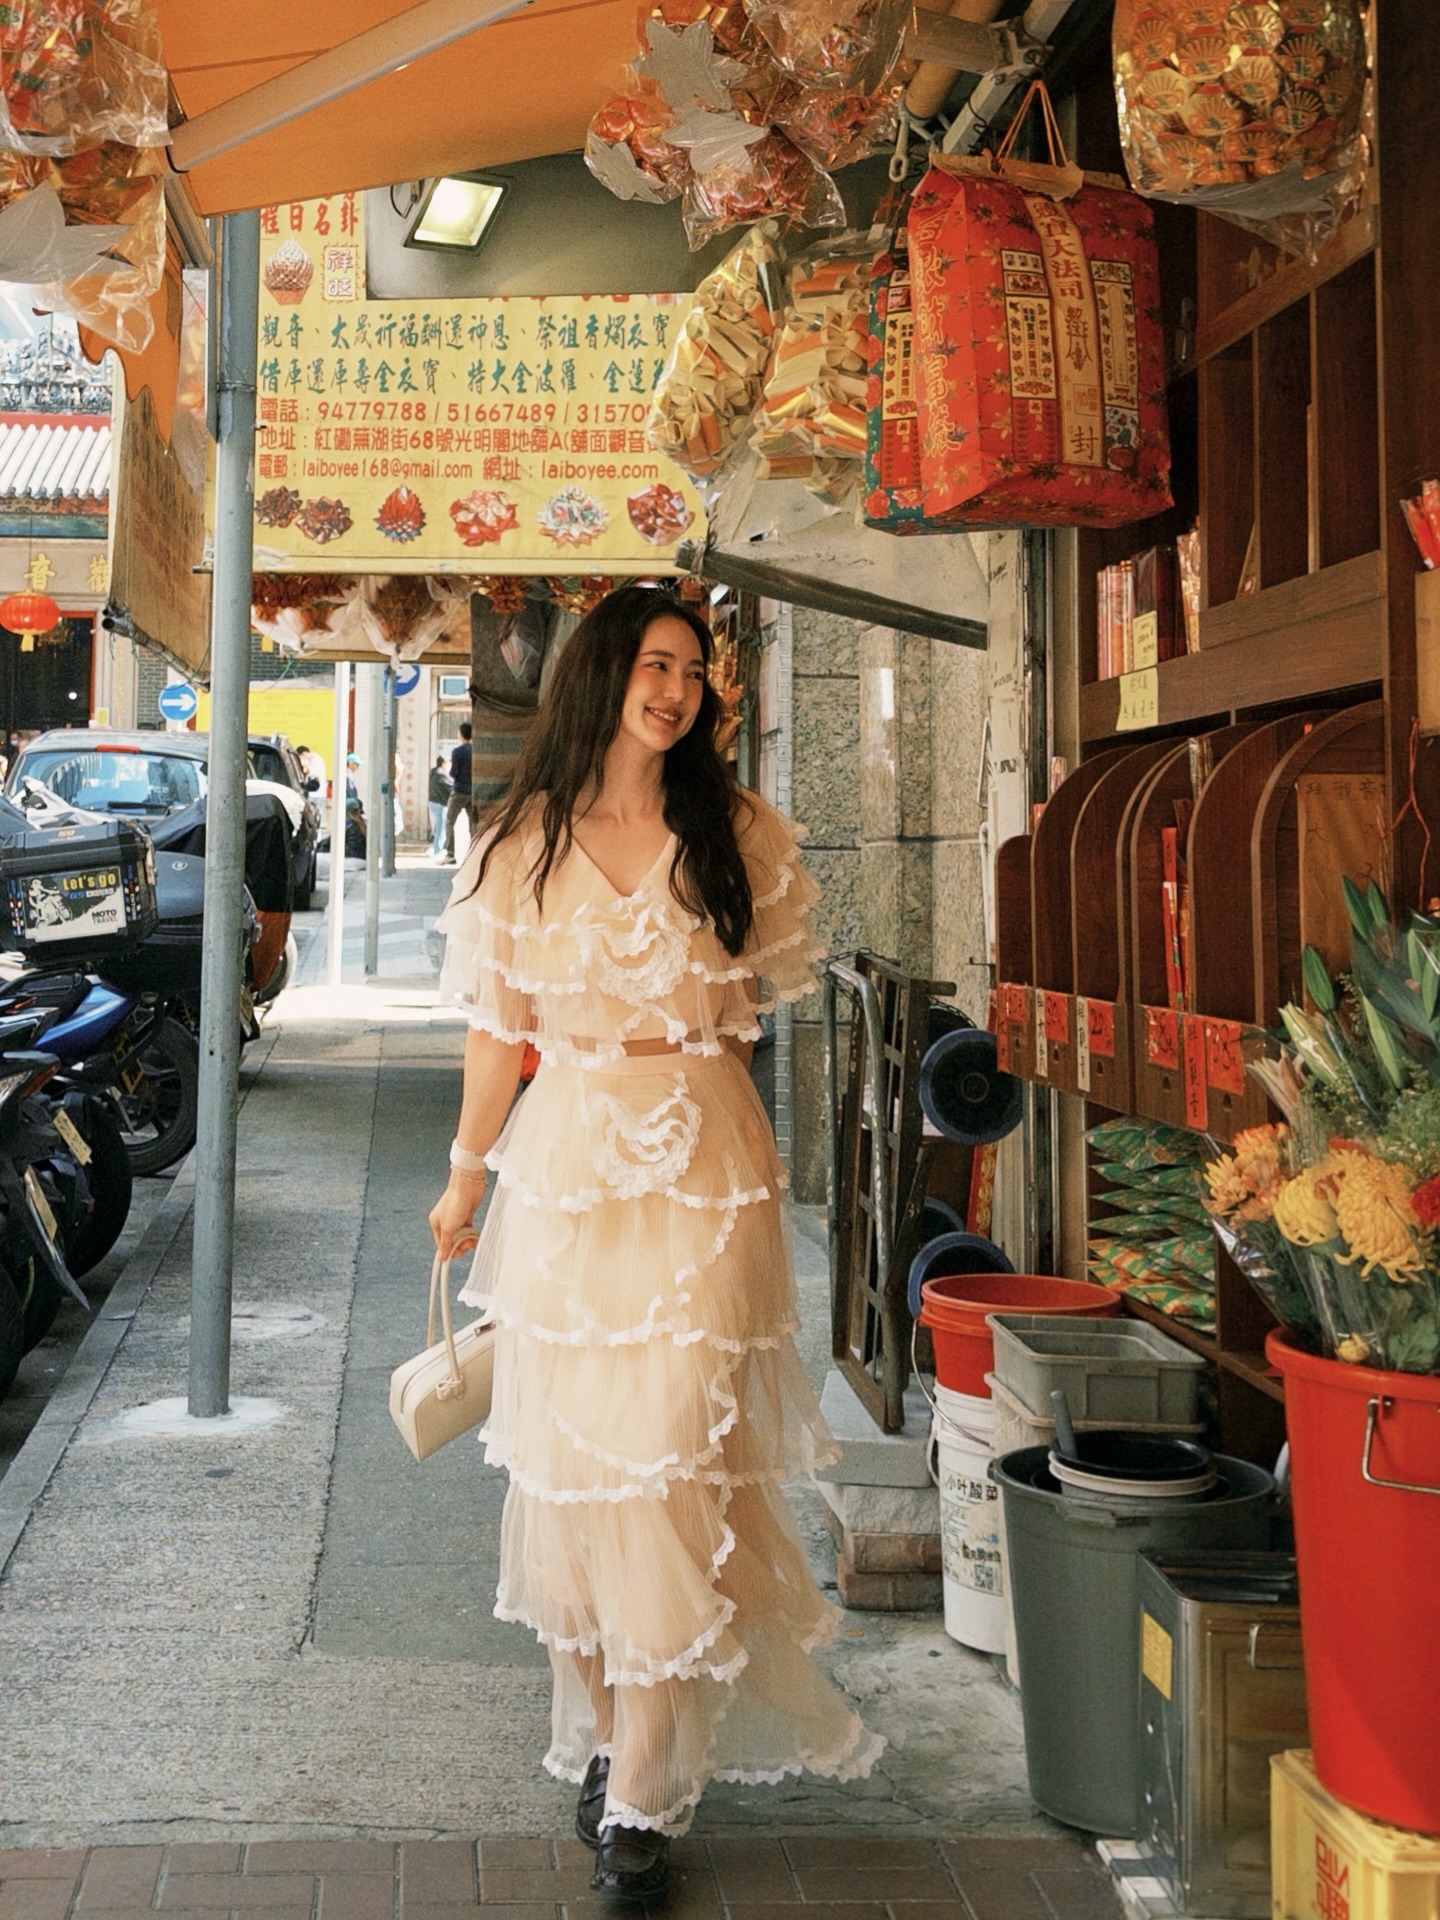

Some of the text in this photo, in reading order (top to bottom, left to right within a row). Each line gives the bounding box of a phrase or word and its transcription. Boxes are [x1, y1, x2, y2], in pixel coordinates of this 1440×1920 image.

[317, 401, 427, 422] 94779788
[447, 402, 556, 423] 51667489
[577, 403, 653, 424] 31570
[1070, 425, 1099, 461] 封
[303, 457, 473, 480] laiboyee168@gmail.com
[541, 459, 659, 481] laiboyee.com
[63, 873, 116, 891] Let's go
[92, 909, 117, 918] MOTO
